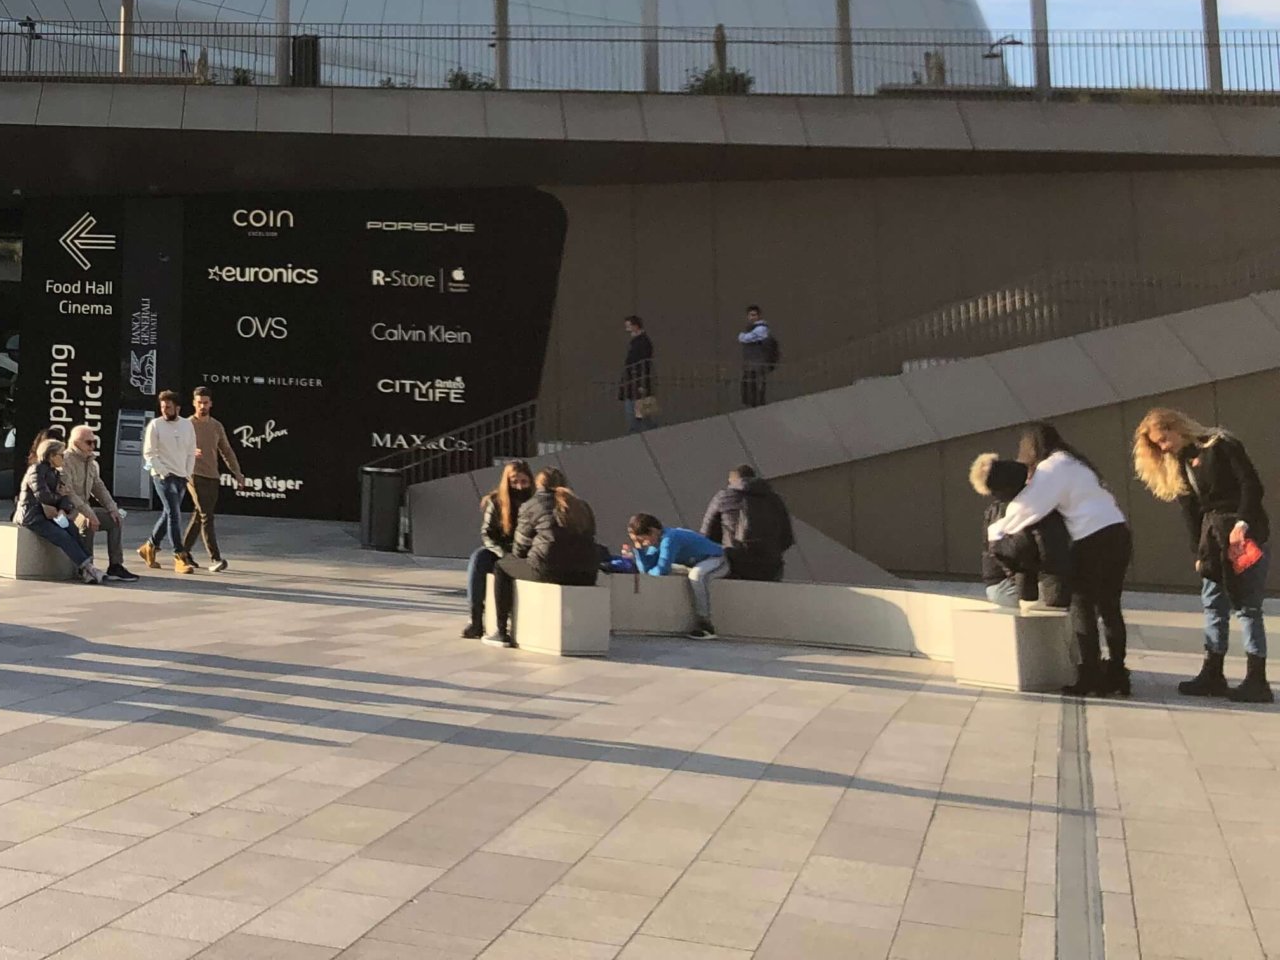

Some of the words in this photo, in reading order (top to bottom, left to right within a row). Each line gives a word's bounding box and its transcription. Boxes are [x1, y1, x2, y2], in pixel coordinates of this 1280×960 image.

[366, 221, 476, 233] PORSCHE
[221, 263, 319, 285] euronics
[371, 269, 436, 288] R-Store
[46, 279, 81, 294] Food
[85, 281, 113, 295] Hall
[59, 300, 113, 315] Cinema
[141, 298, 150, 345] GENERALI
[150, 312, 158, 345] PRIVATE
[237, 316, 288, 339] OVS
[371, 322, 426, 341] Calvin
[428, 325, 472, 344] Klein
[202, 374, 250, 384] TOMMY
[268, 377, 323, 387] HILFIGER
[377, 379, 432, 394] CITY
[414, 388, 466, 403] LIFE
[79, 371, 103, 457] trict
[233, 420, 289, 449] Ray-Ban
[220, 473, 263, 490] flyng
[264, 476, 304, 492] tiger
[235, 490, 286, 500] copenhagen
